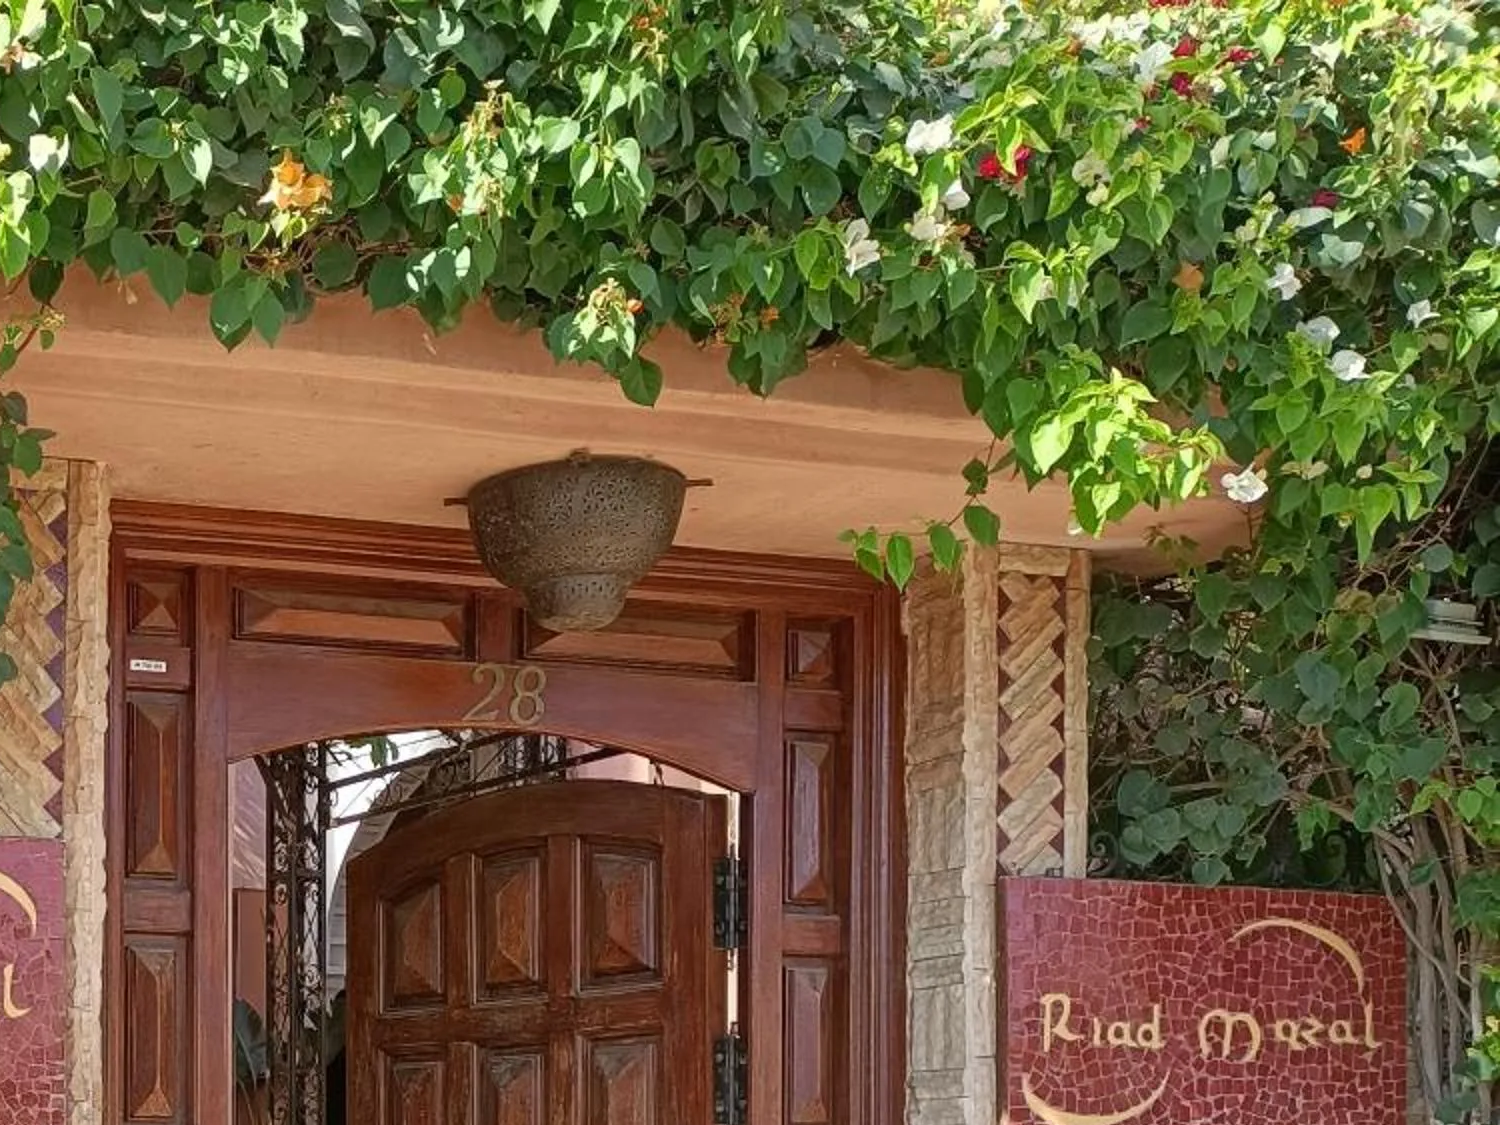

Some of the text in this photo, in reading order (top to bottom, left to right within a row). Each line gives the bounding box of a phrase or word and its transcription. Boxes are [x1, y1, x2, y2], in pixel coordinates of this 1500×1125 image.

[462, 663, 546, 724] 28
[1039, 993, 1382, 1063] Riad Mazal
